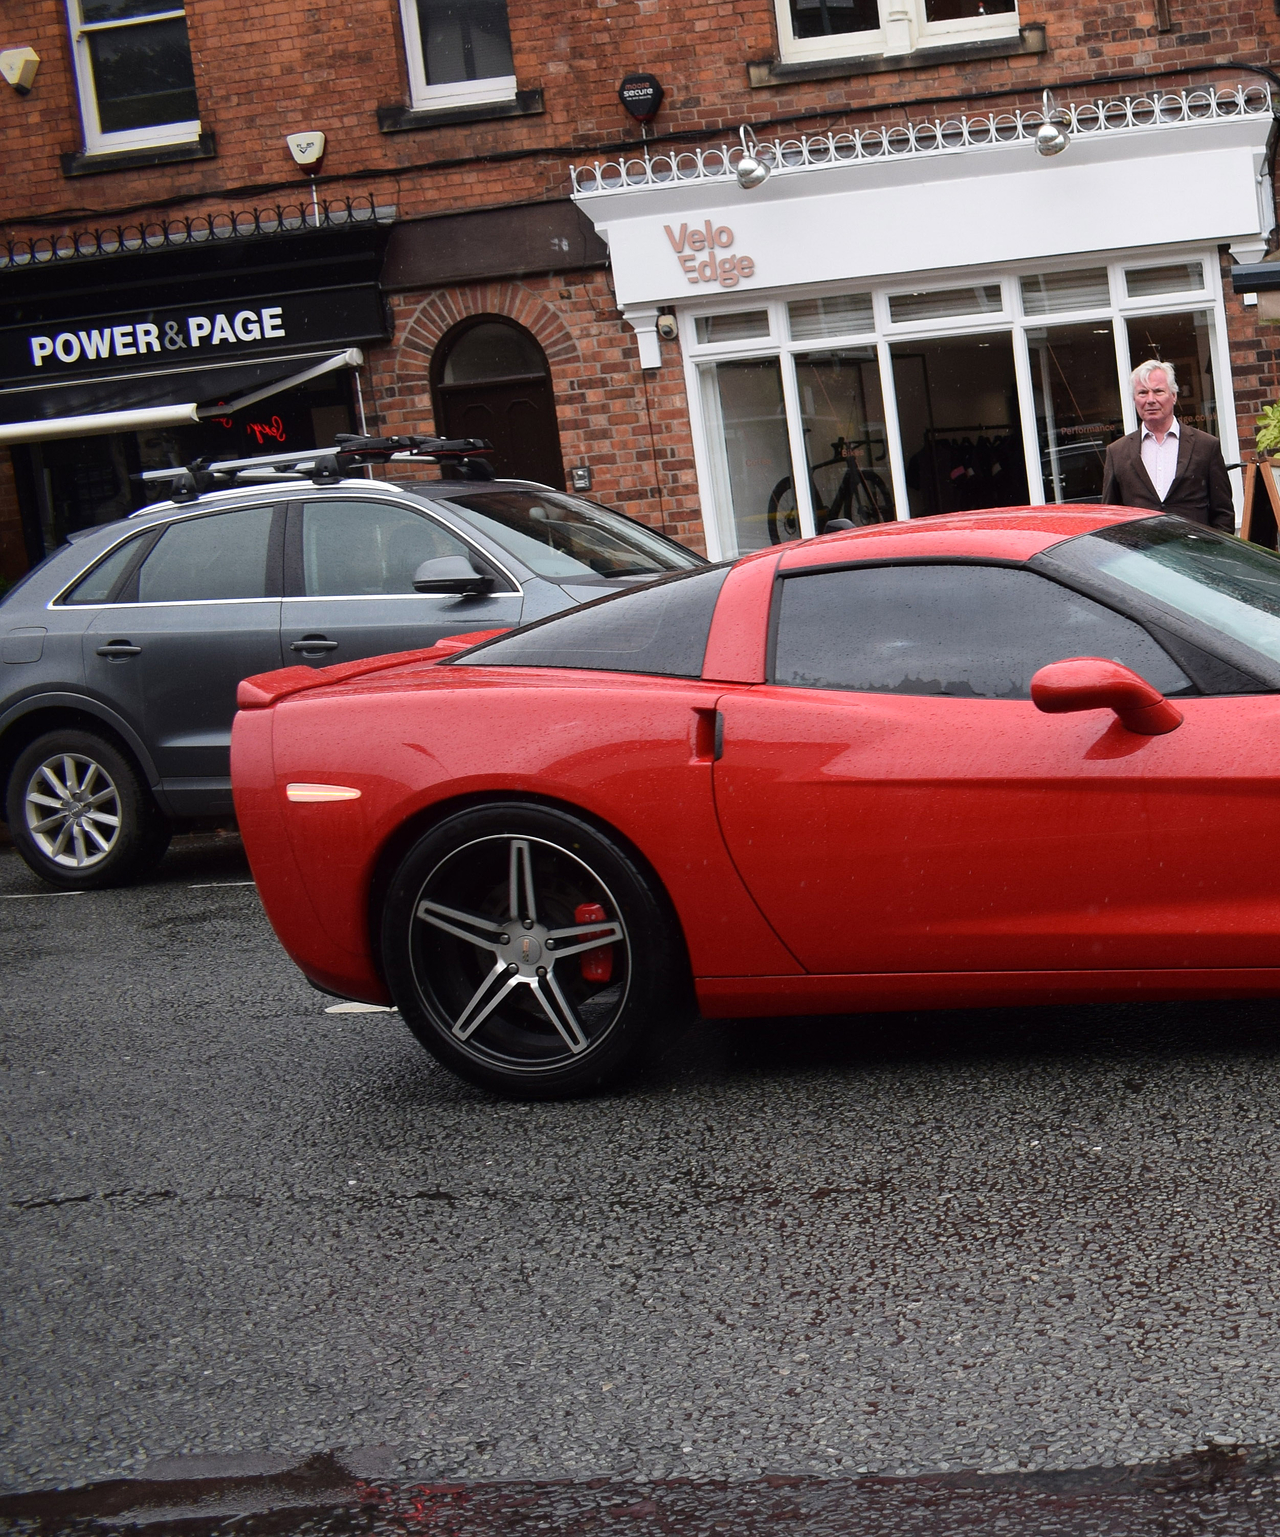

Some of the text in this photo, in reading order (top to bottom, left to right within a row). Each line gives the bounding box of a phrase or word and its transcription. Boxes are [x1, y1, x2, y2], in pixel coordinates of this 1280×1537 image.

[623, 88, 654, 97] secure
[663, 219, 734, 253] Velo
[677, 251, 755, 287] Edge
[1060, 424, 1115, 435] Performance
